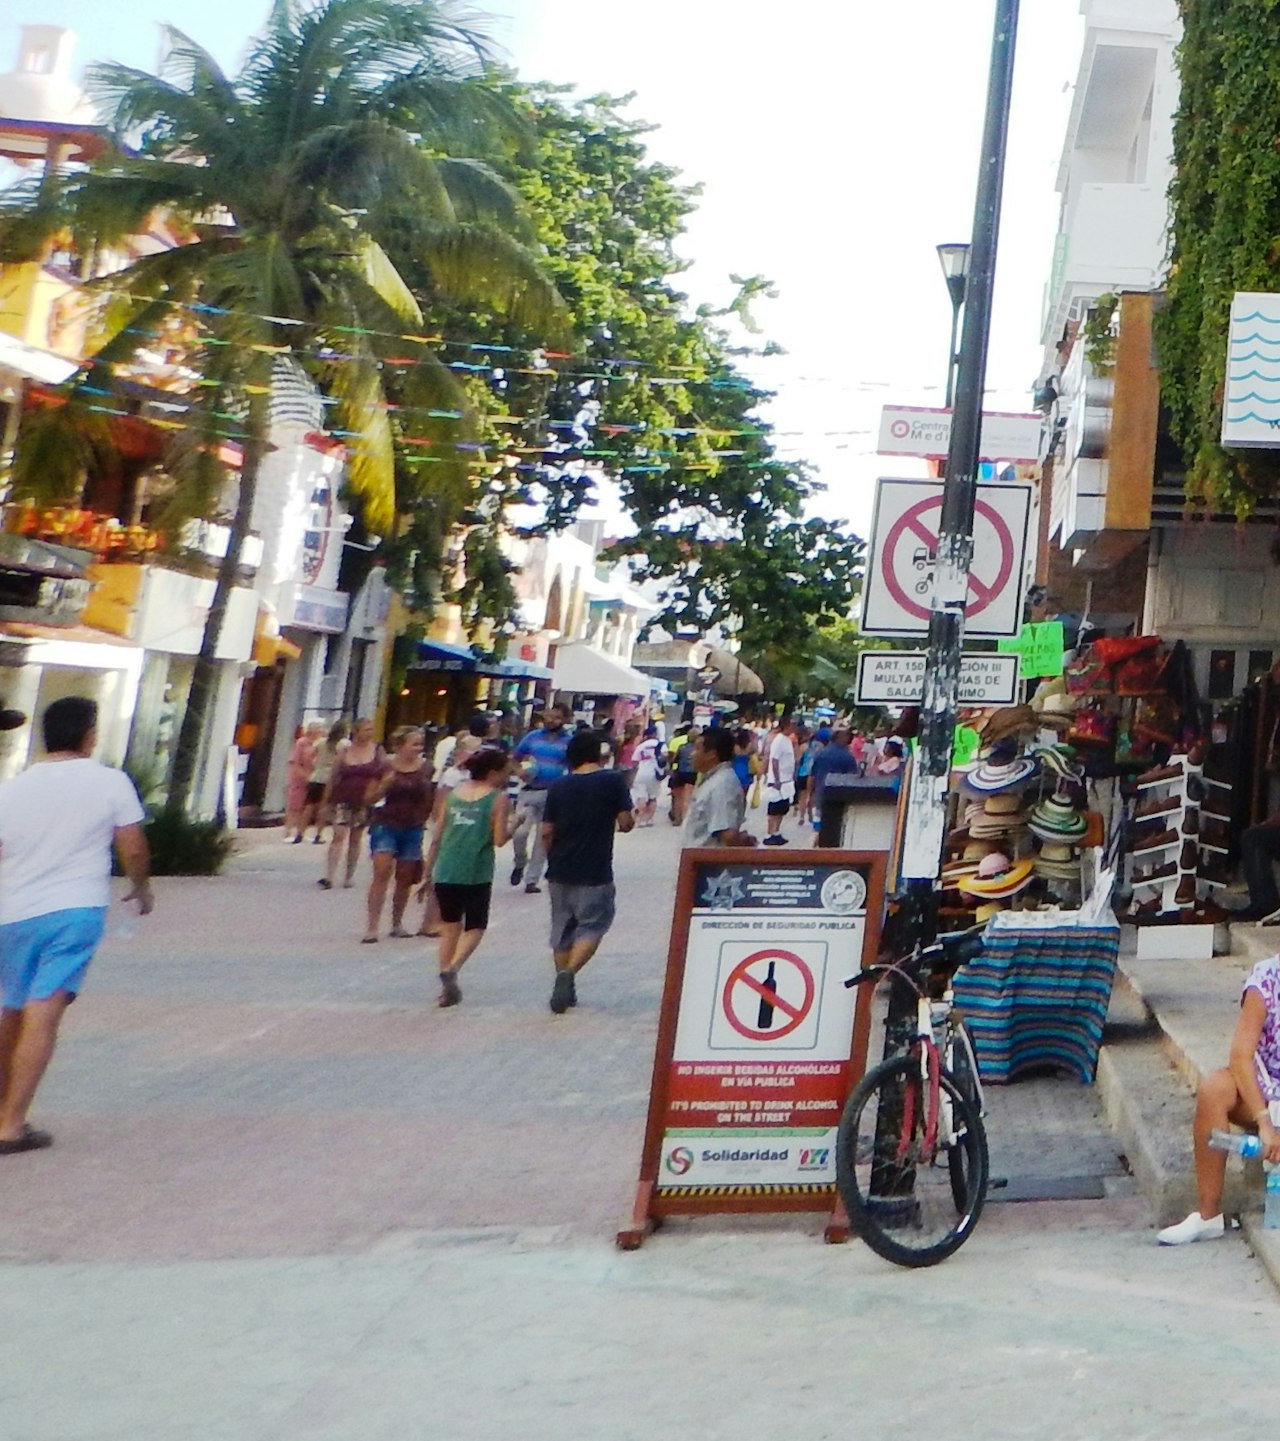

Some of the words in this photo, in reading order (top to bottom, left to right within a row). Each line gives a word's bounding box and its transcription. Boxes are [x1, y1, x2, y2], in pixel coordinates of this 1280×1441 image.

[912, 420, 950, 432] Centra
[910, 429, 950, 441] Medi
[875, 661, 899, 671] ART.
[905, 662, 924, 671] 150
[960, 661, 989, 672] CIÓN
[992, 663, 1002, 672] III
[873, 674, 912, 683] MULTA
[985, 675, 1000, 685] DE
[886, 687, 924, 697] SALA
[958, 687, 986, 698] NIMO
[701, 921, 750, 930] DIRECCIÓN
[752, 921, 763, 930] DE
[766, 921, 817, 930] SEGURIDAD
[677, 1065, 692, 1075] NO
[734, 1065, 775, 1075] BEBIDAS
[720, 1077, 735, 1087] EN
[691, 1101, 748, 1110] PROHIBITED
[750, 1101, 762, 1110] TO
[764, 1101, 794, 1110] DRINK
[795, 1100, 839, 1110] ALCOHOL
[716, 1112, 732, 1123] ON
[734, 1112, 752, 1122] THE
[754, 1112, 791, 1122] STREET
[702, 1148, 789, 1162] Solidaridad
